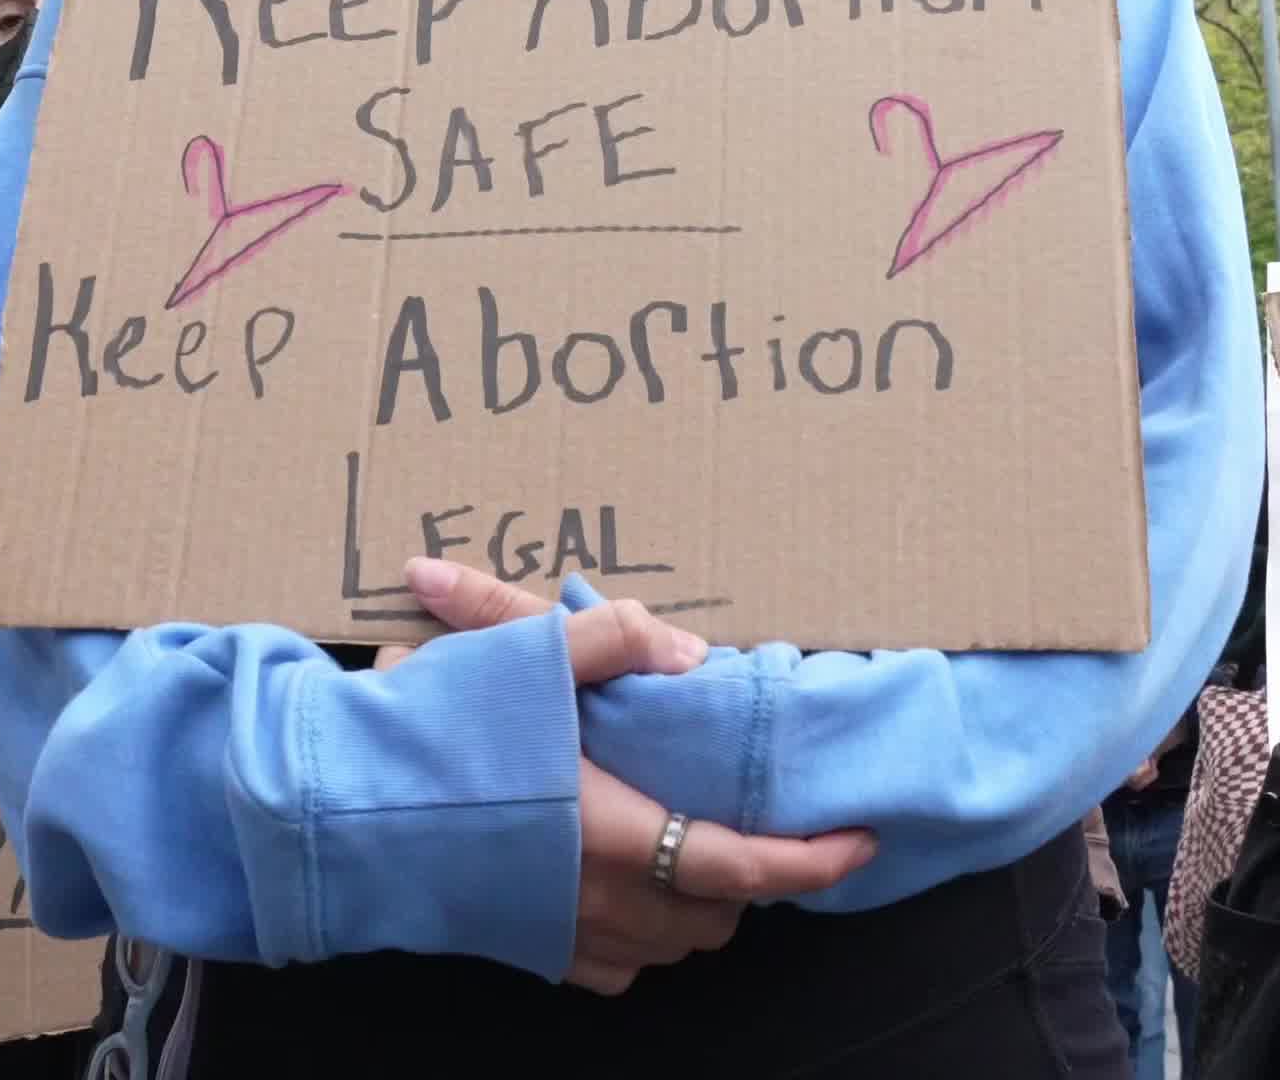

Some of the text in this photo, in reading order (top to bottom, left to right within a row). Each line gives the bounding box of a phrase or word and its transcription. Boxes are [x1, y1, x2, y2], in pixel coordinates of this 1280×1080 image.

[354, 87, 675, 214] SAFE
[24, 262, 954, 426] Keep Abortion
[342, 451, 675, 599] LEGAL
